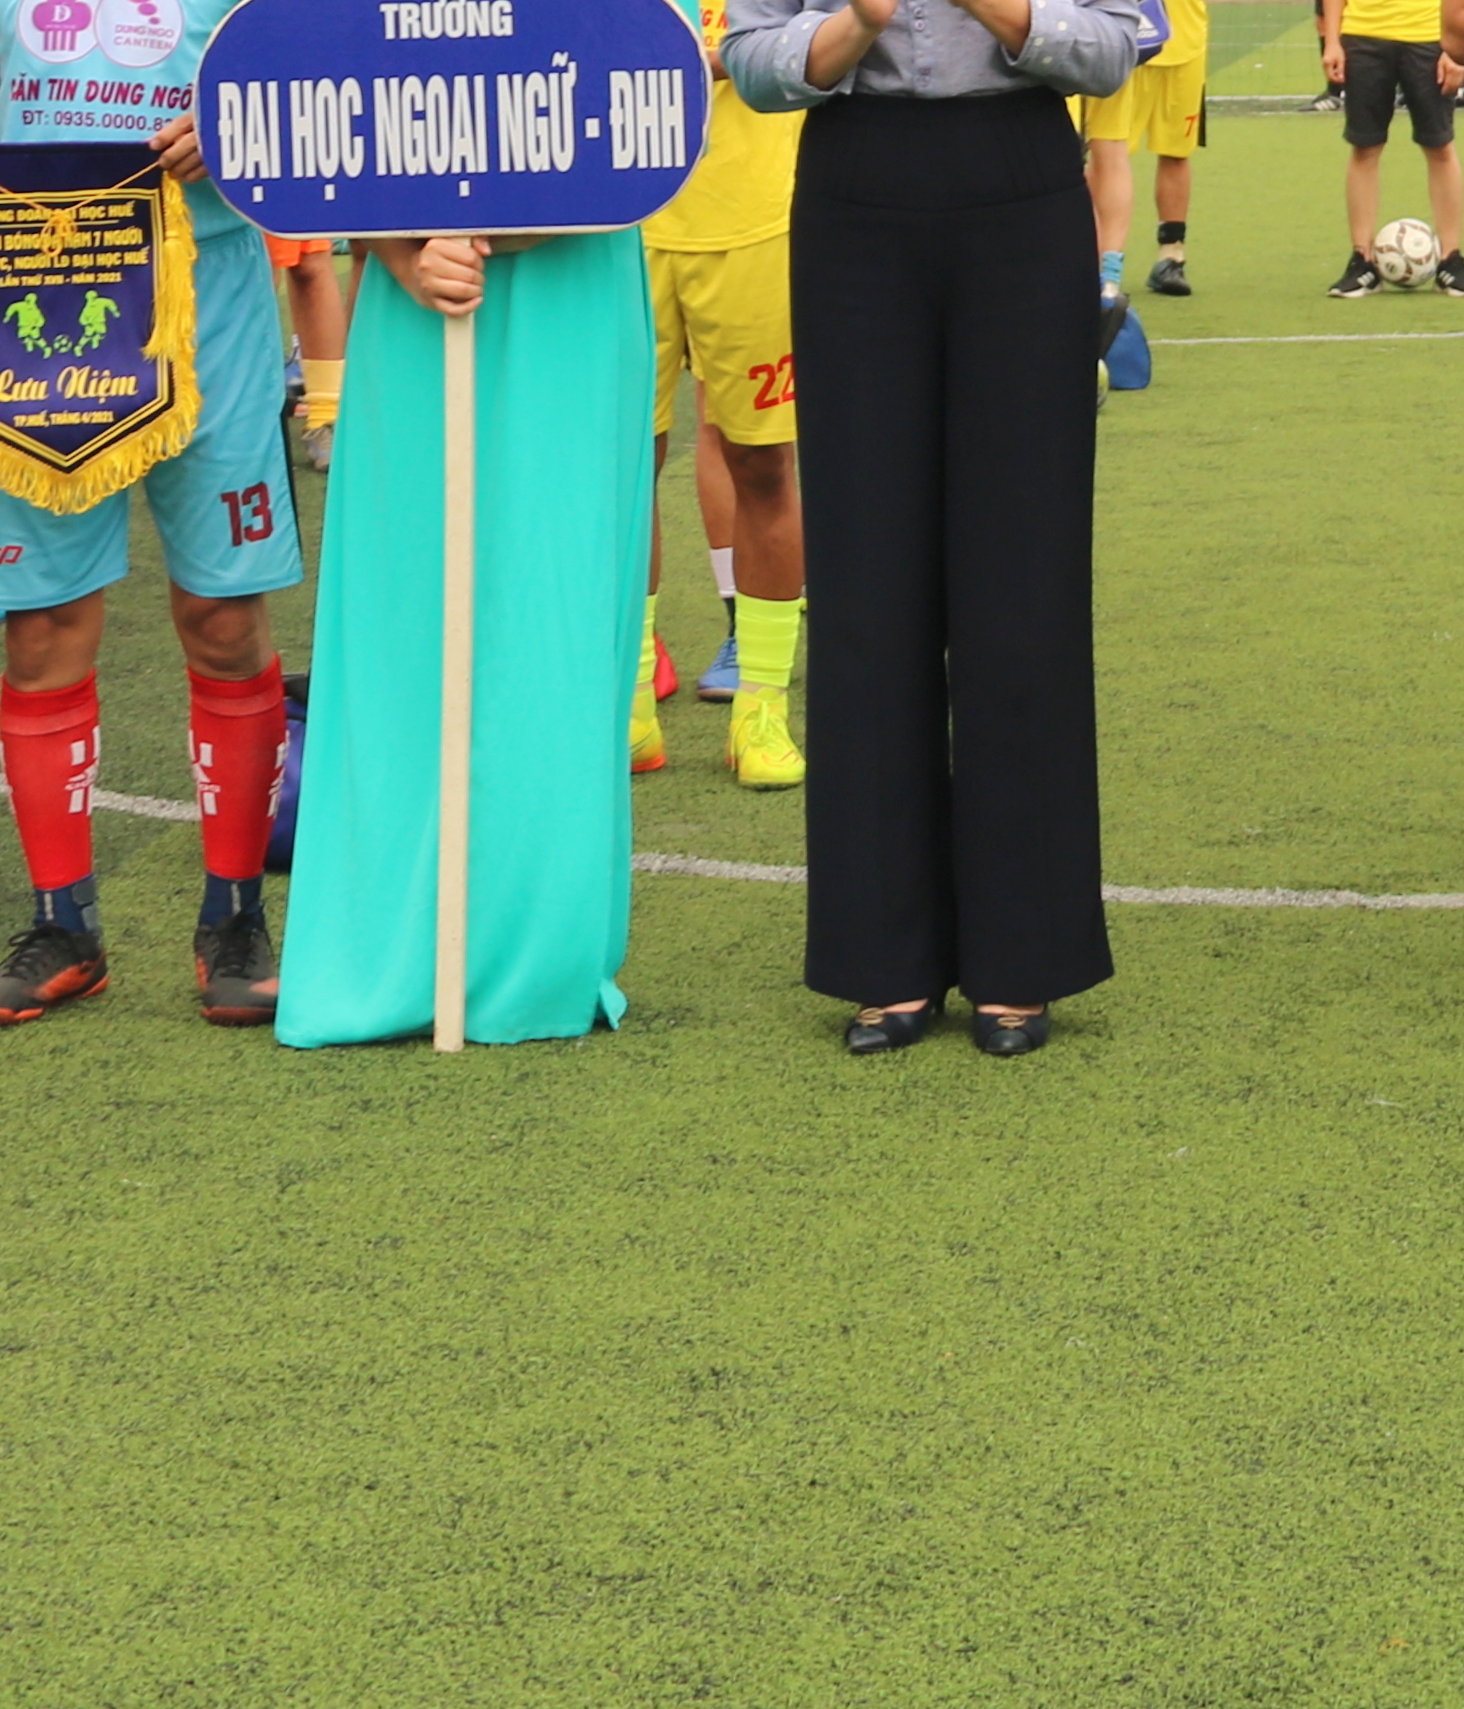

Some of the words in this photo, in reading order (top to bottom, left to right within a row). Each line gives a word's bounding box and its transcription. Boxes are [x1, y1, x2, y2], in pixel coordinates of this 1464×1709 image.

[114, 36, 173, 51] CANTEEN
[48, 79, 78, 101] TIN
[85, 81, 145, 105] DUNG
[151, 83, 193, 109] NGÔ
[22, 110, 49, 125] ĐT:
[218, 81, 281, 202] ĐẠI
[289, 77, 364, 200] HỌC
[373, 74, 488, 196] NGOẠI
[497, 52, 577, 173] NGỮ
[585, 118, 599, 137] -
[609, 68, 685, 169] ĐHH
[79, 206, 106, 220] HỌC
[109, 200, 135, 217] HUẾ
[92, 232, 102, 247] 7
[124, 246, 150, 265] HUẾ
[57, 365, 139, 404] Niệm
[748, 353, 796, 410] 22
[221, 481, 275, 548] 13
